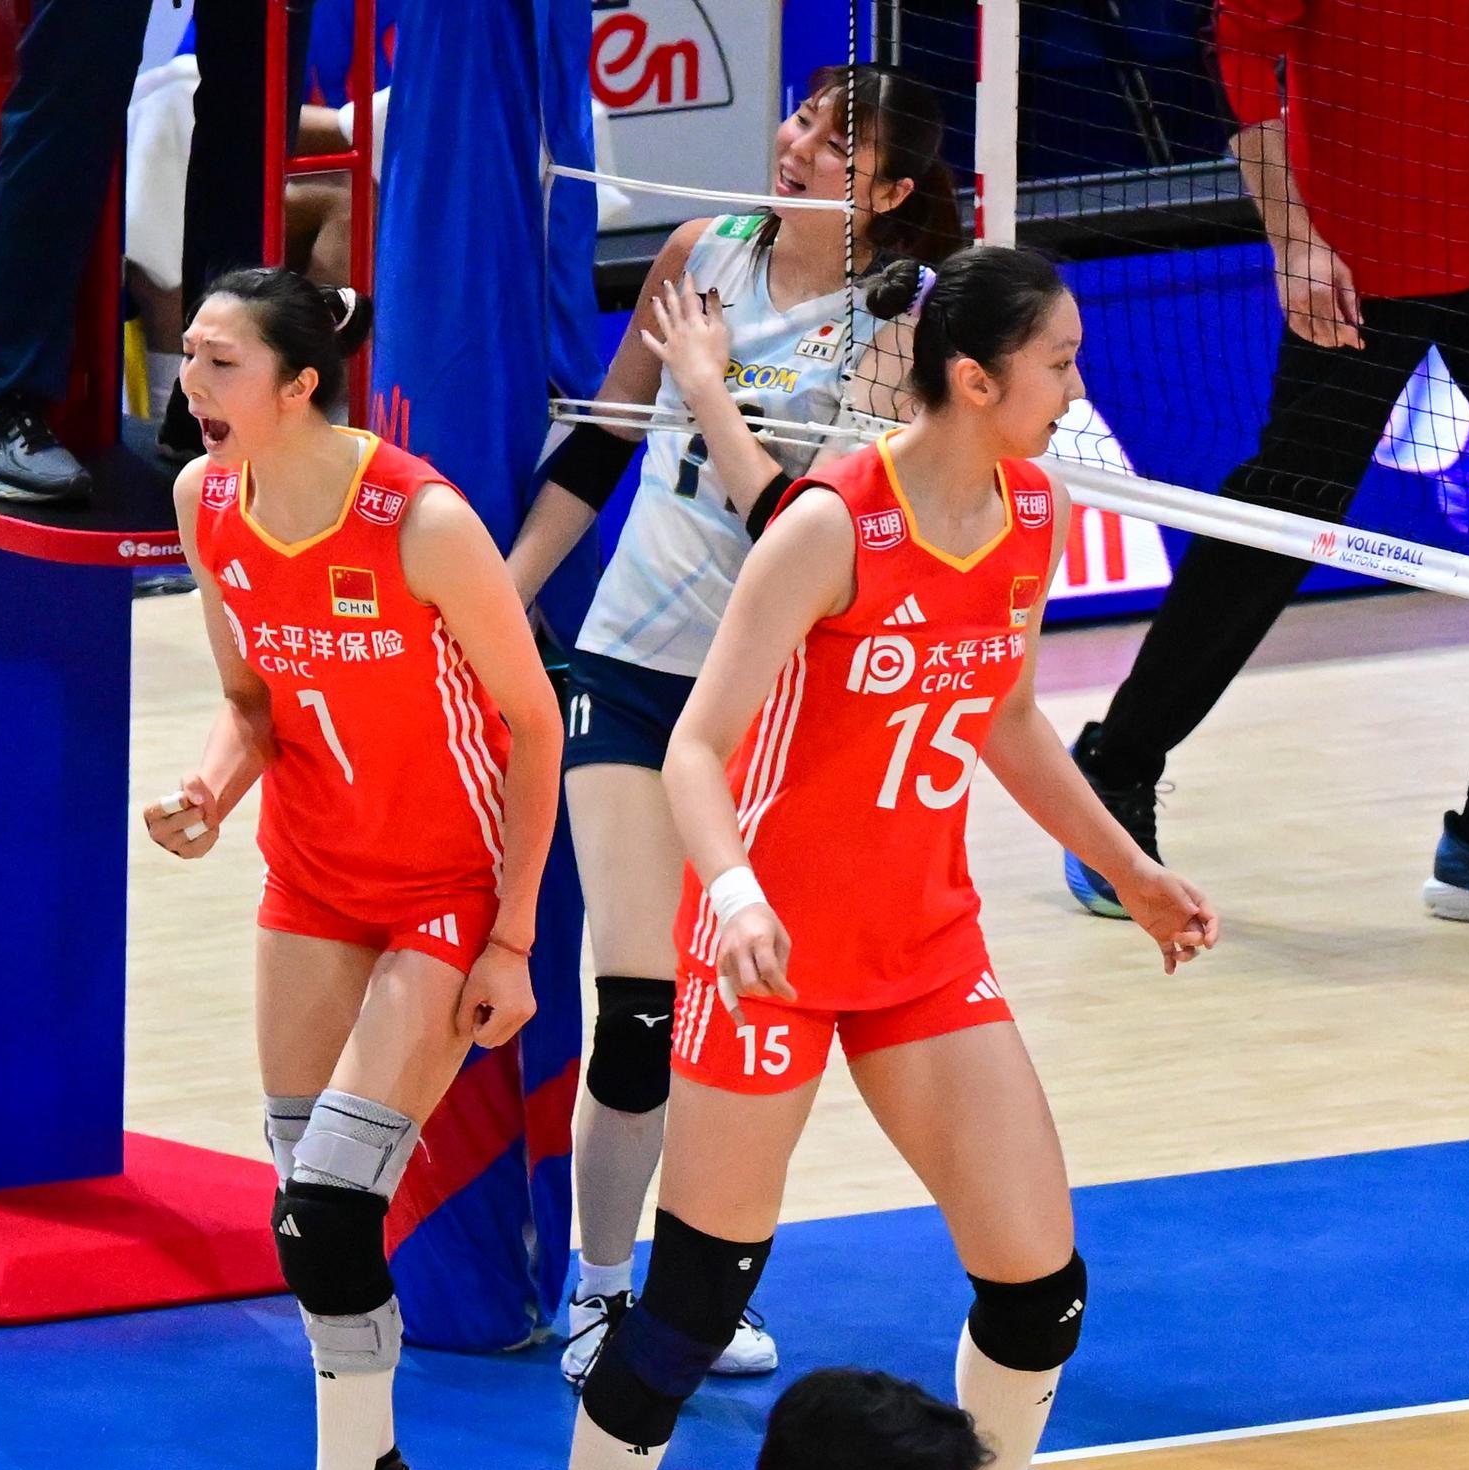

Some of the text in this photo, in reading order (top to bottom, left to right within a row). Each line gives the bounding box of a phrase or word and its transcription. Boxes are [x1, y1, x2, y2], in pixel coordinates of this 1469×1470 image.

[801, 343, 828, 357] JPN
[724, 359, 799, 393] PCOM
[359, 487, 406, 519] 光明
[1015, 493, 1047, 515] 光明
[861, 516, 902, 537] 光明
[136, 542, 185, 557] Seno
[1346, 534, 1423, 565] VOLLEYBALL
[337, 601, 372, 614] CHN
[252, 622, 405, 662] 太平洋保险
[923, 634, 1026, 670] 太平洋保
[259, 655, 314, 679] CPIC
[921, 671, 976, 694] CPIC
[569, 693, 591, 738] 11
[876, 697, 994, 810] 15
[736, 1025, 791, 1075] 15
